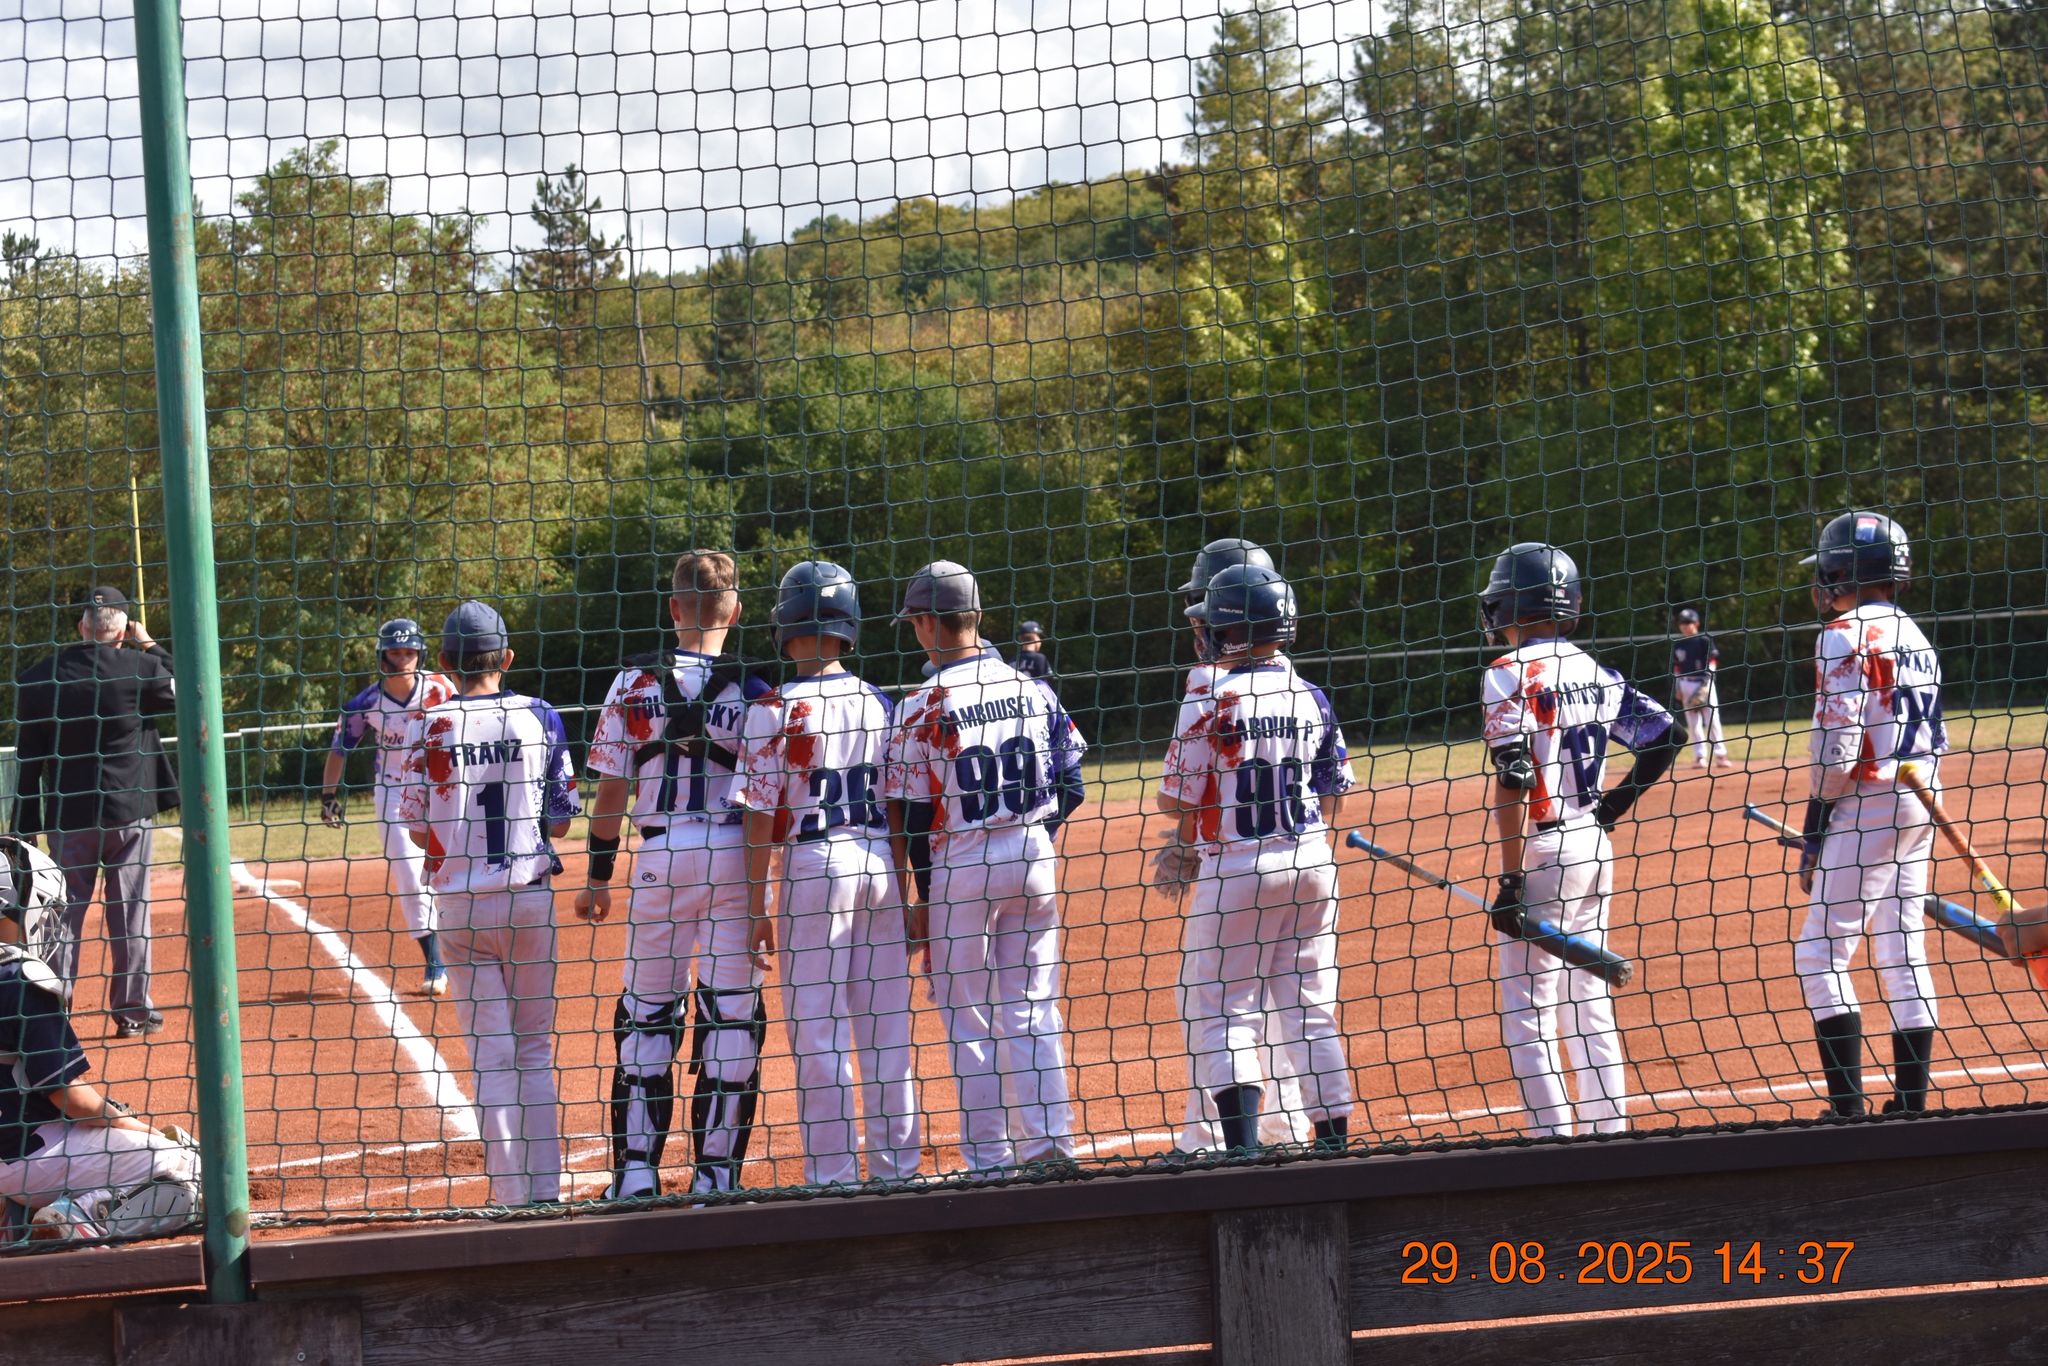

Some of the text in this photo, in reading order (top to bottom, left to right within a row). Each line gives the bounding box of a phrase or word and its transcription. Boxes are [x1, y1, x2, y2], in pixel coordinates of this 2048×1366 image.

[1276, 598, 1297, 617] 96
[449, 738, 524, 768] FRANZ
[656, 749, 706, 812] 11
[954, 735, 1037, 824] 99
[476, 781, 506, 865] 1
[800, 762, 885, 832] 36
